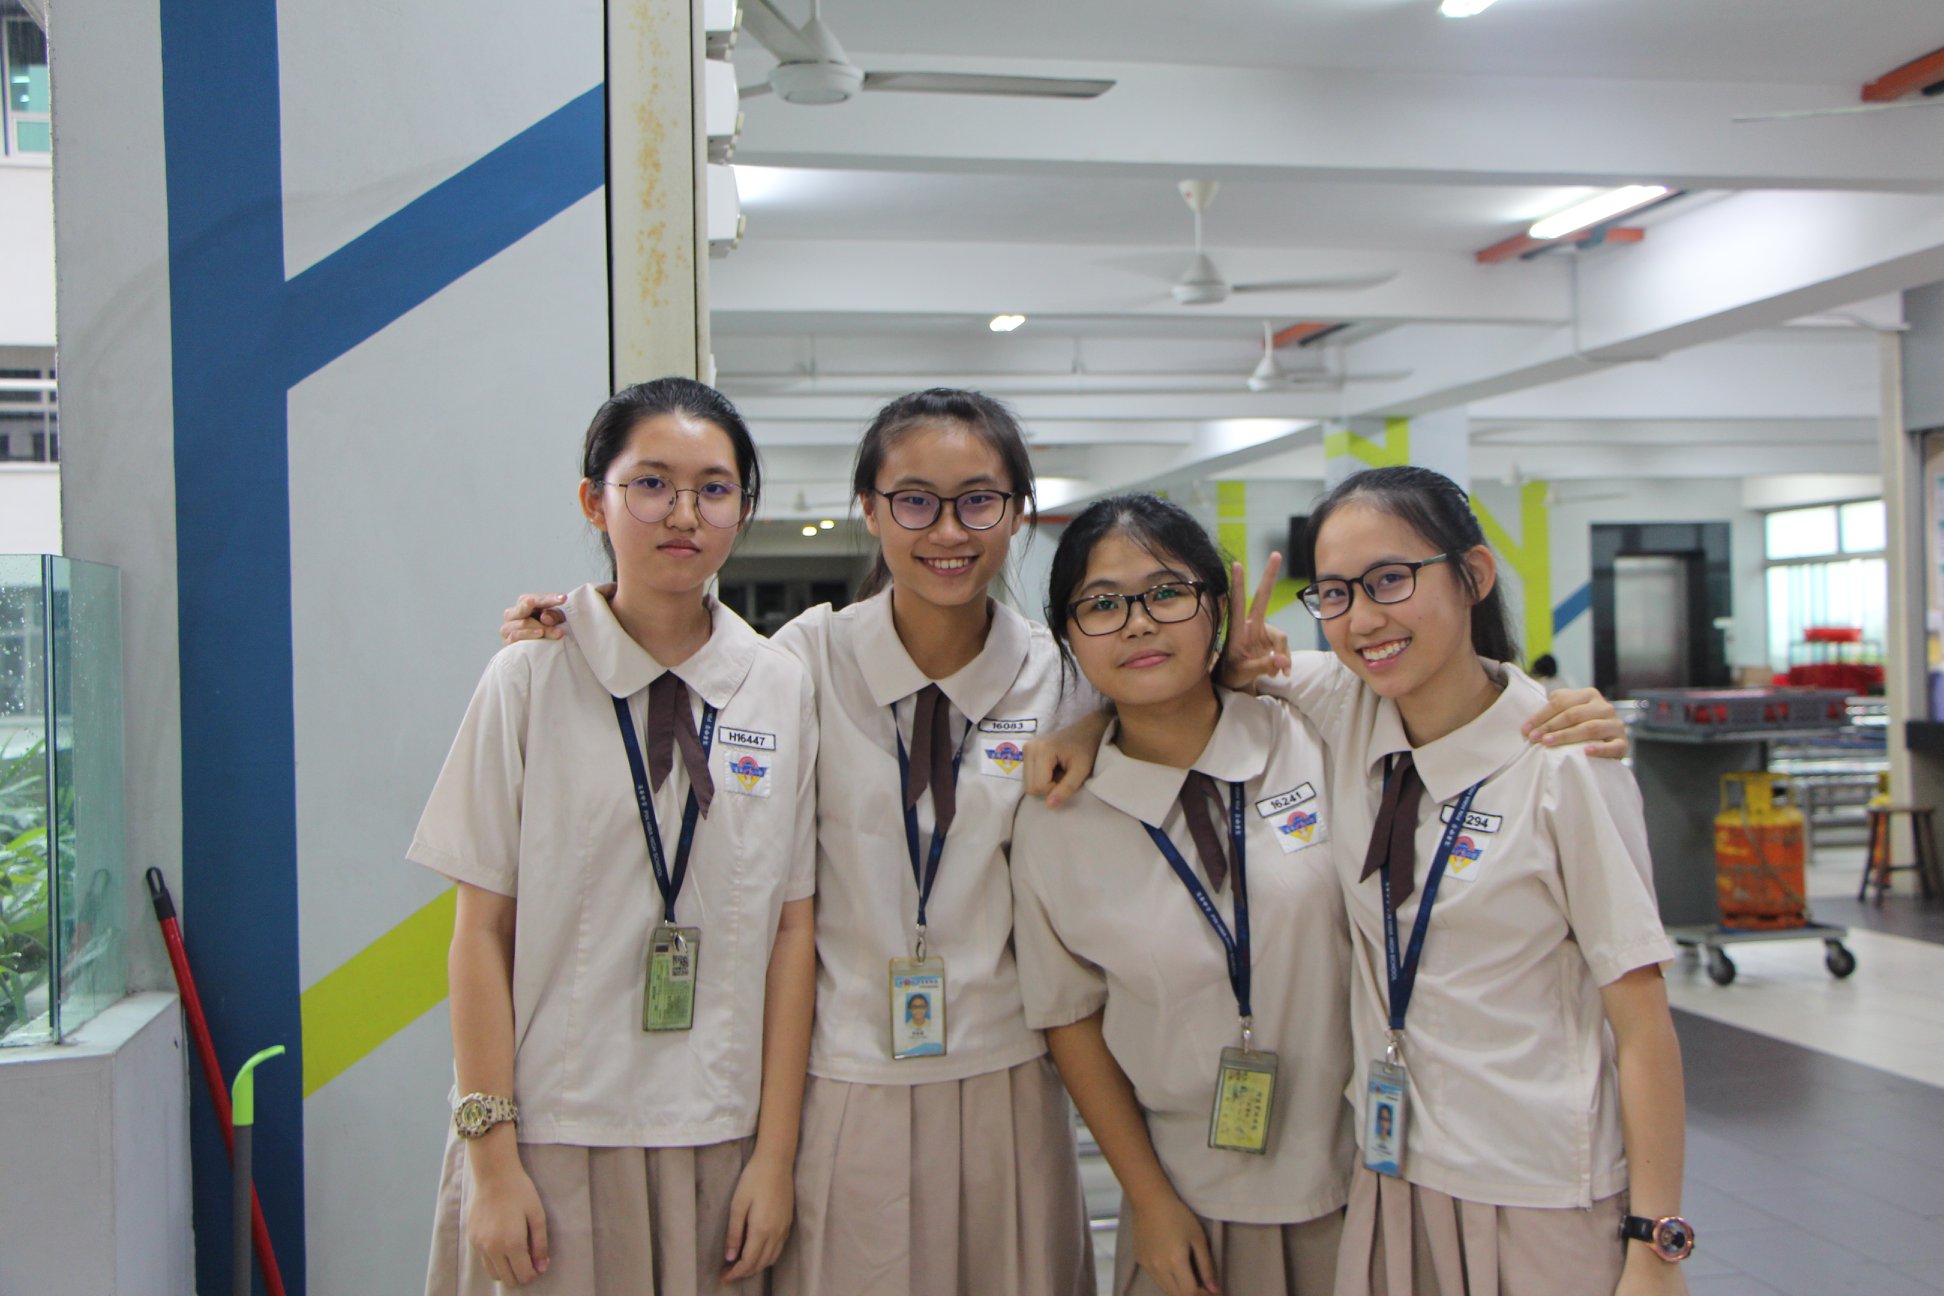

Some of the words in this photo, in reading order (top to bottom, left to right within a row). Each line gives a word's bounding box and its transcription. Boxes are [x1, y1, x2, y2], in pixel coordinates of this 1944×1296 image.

[992, 722, 1024, 730] 16083
[729, 731, 766, 746] H16447
[1270, 791, 1302, 810] 16241
[1463, 814, 1489, 829] 294
